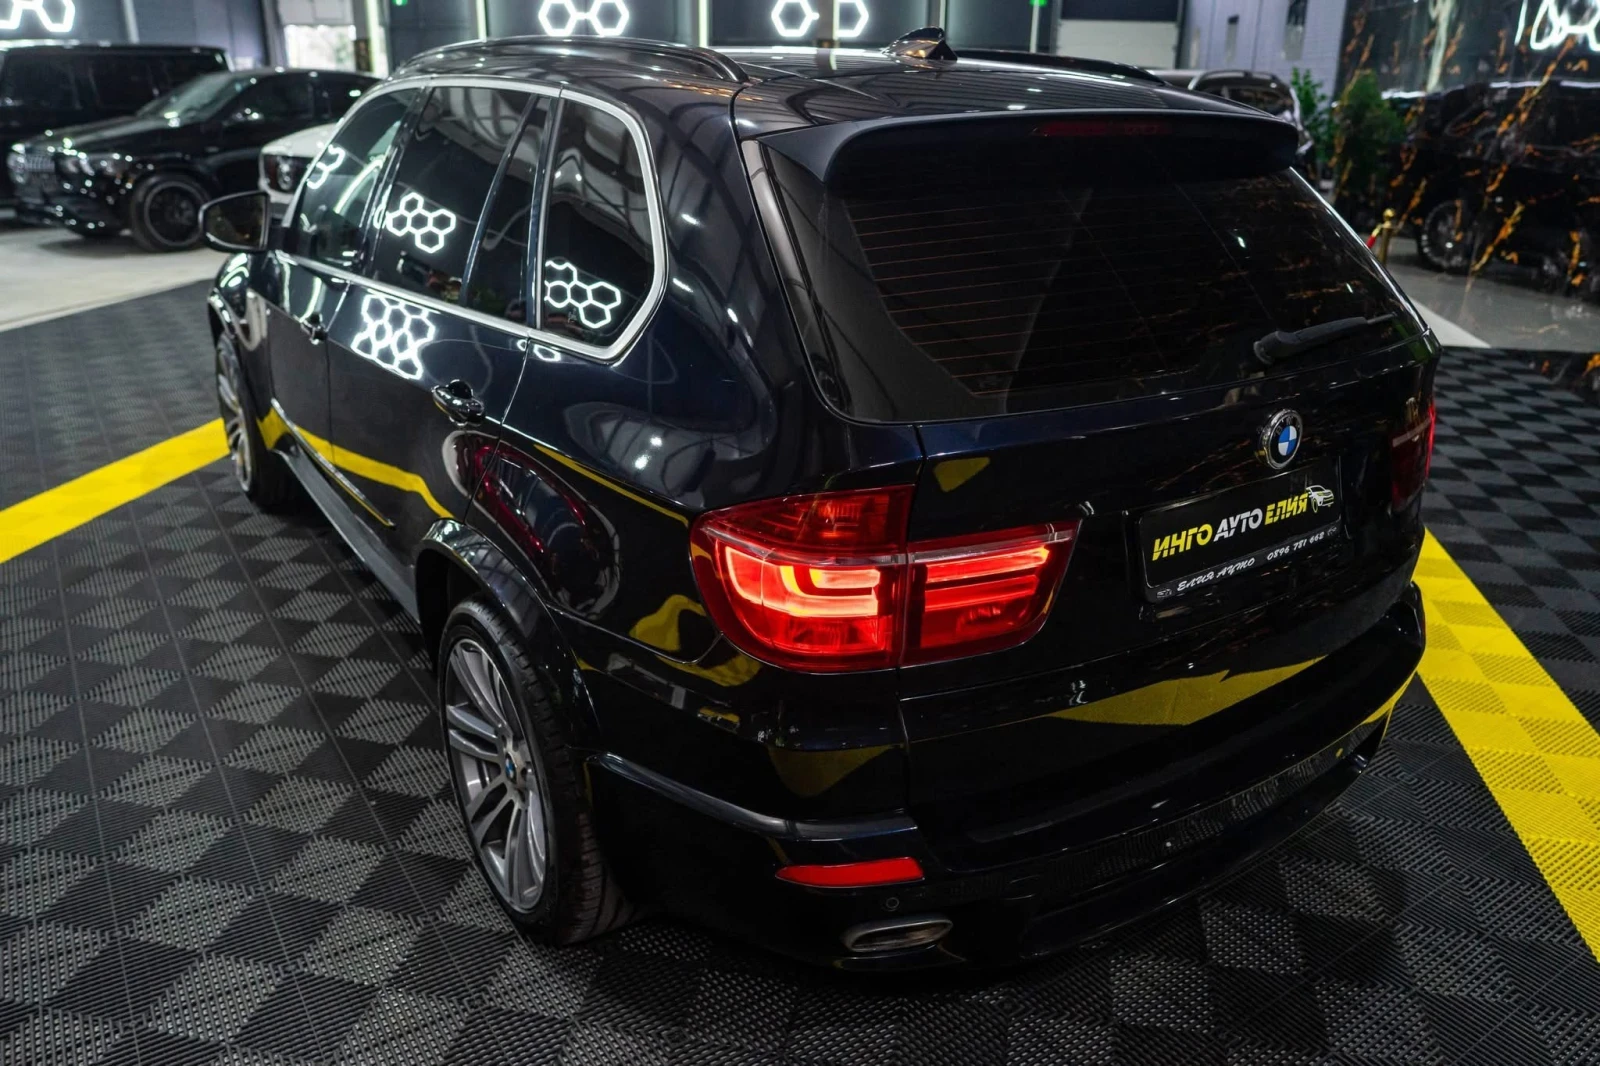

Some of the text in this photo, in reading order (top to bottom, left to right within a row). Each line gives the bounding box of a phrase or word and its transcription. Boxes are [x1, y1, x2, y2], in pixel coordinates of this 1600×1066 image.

[1152, 492, 1309, 561] ИНГО АУТО ЕЛИЯ
[1266, 545, 1290, 561] 0896
[1293, 538, 1307, 551] 781
